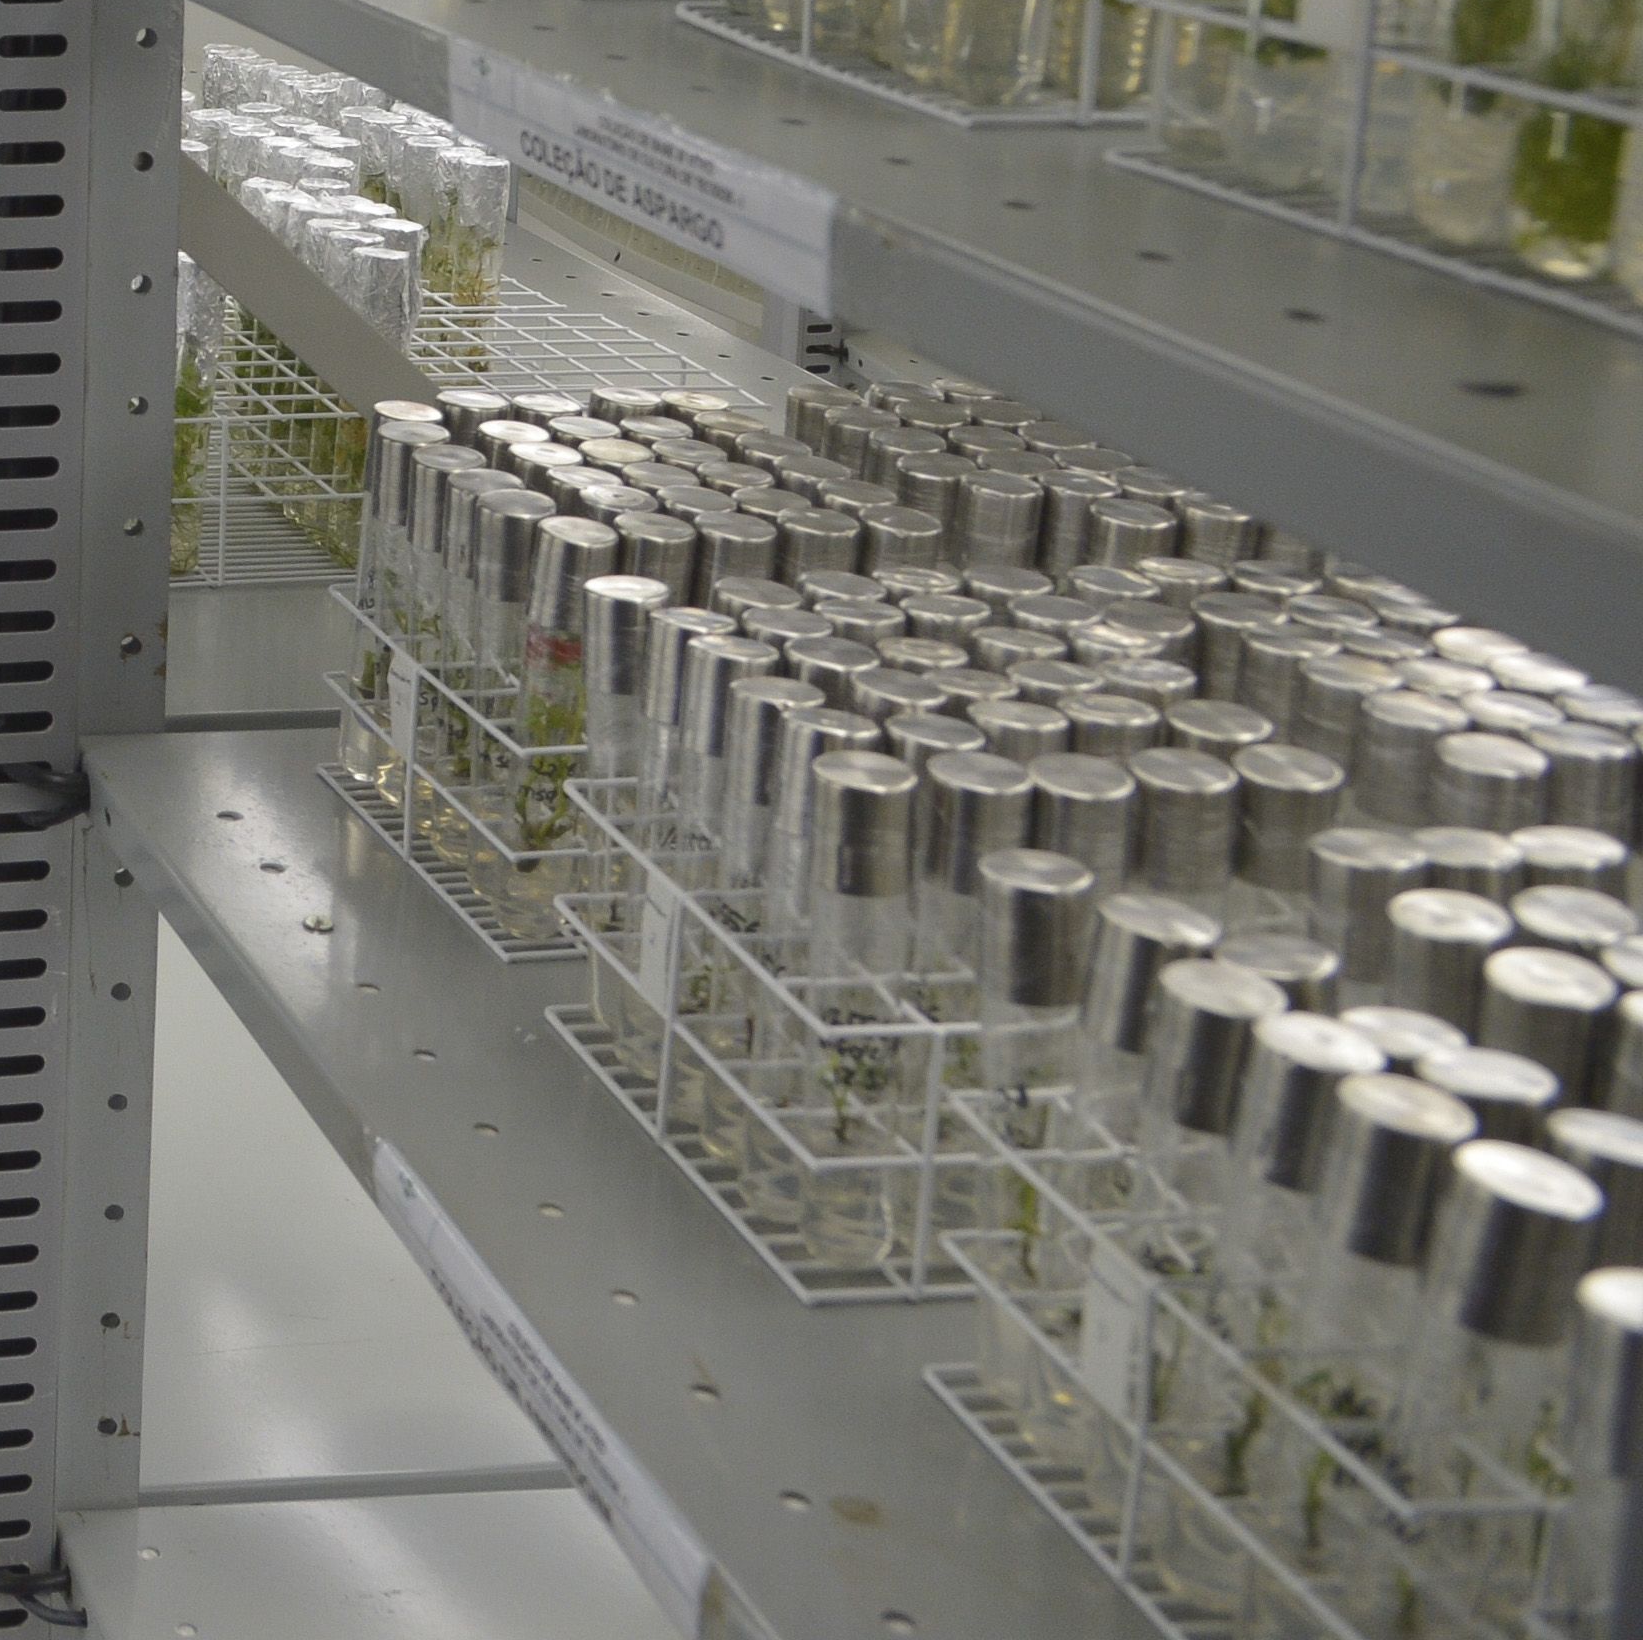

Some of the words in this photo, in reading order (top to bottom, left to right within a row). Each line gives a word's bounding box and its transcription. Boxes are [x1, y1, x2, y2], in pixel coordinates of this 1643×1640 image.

[519, 128, 601, 189] COLEÇÃO
[603, 168, 626, 205] DE
[632, 183, 726, 250] ASPARGO
